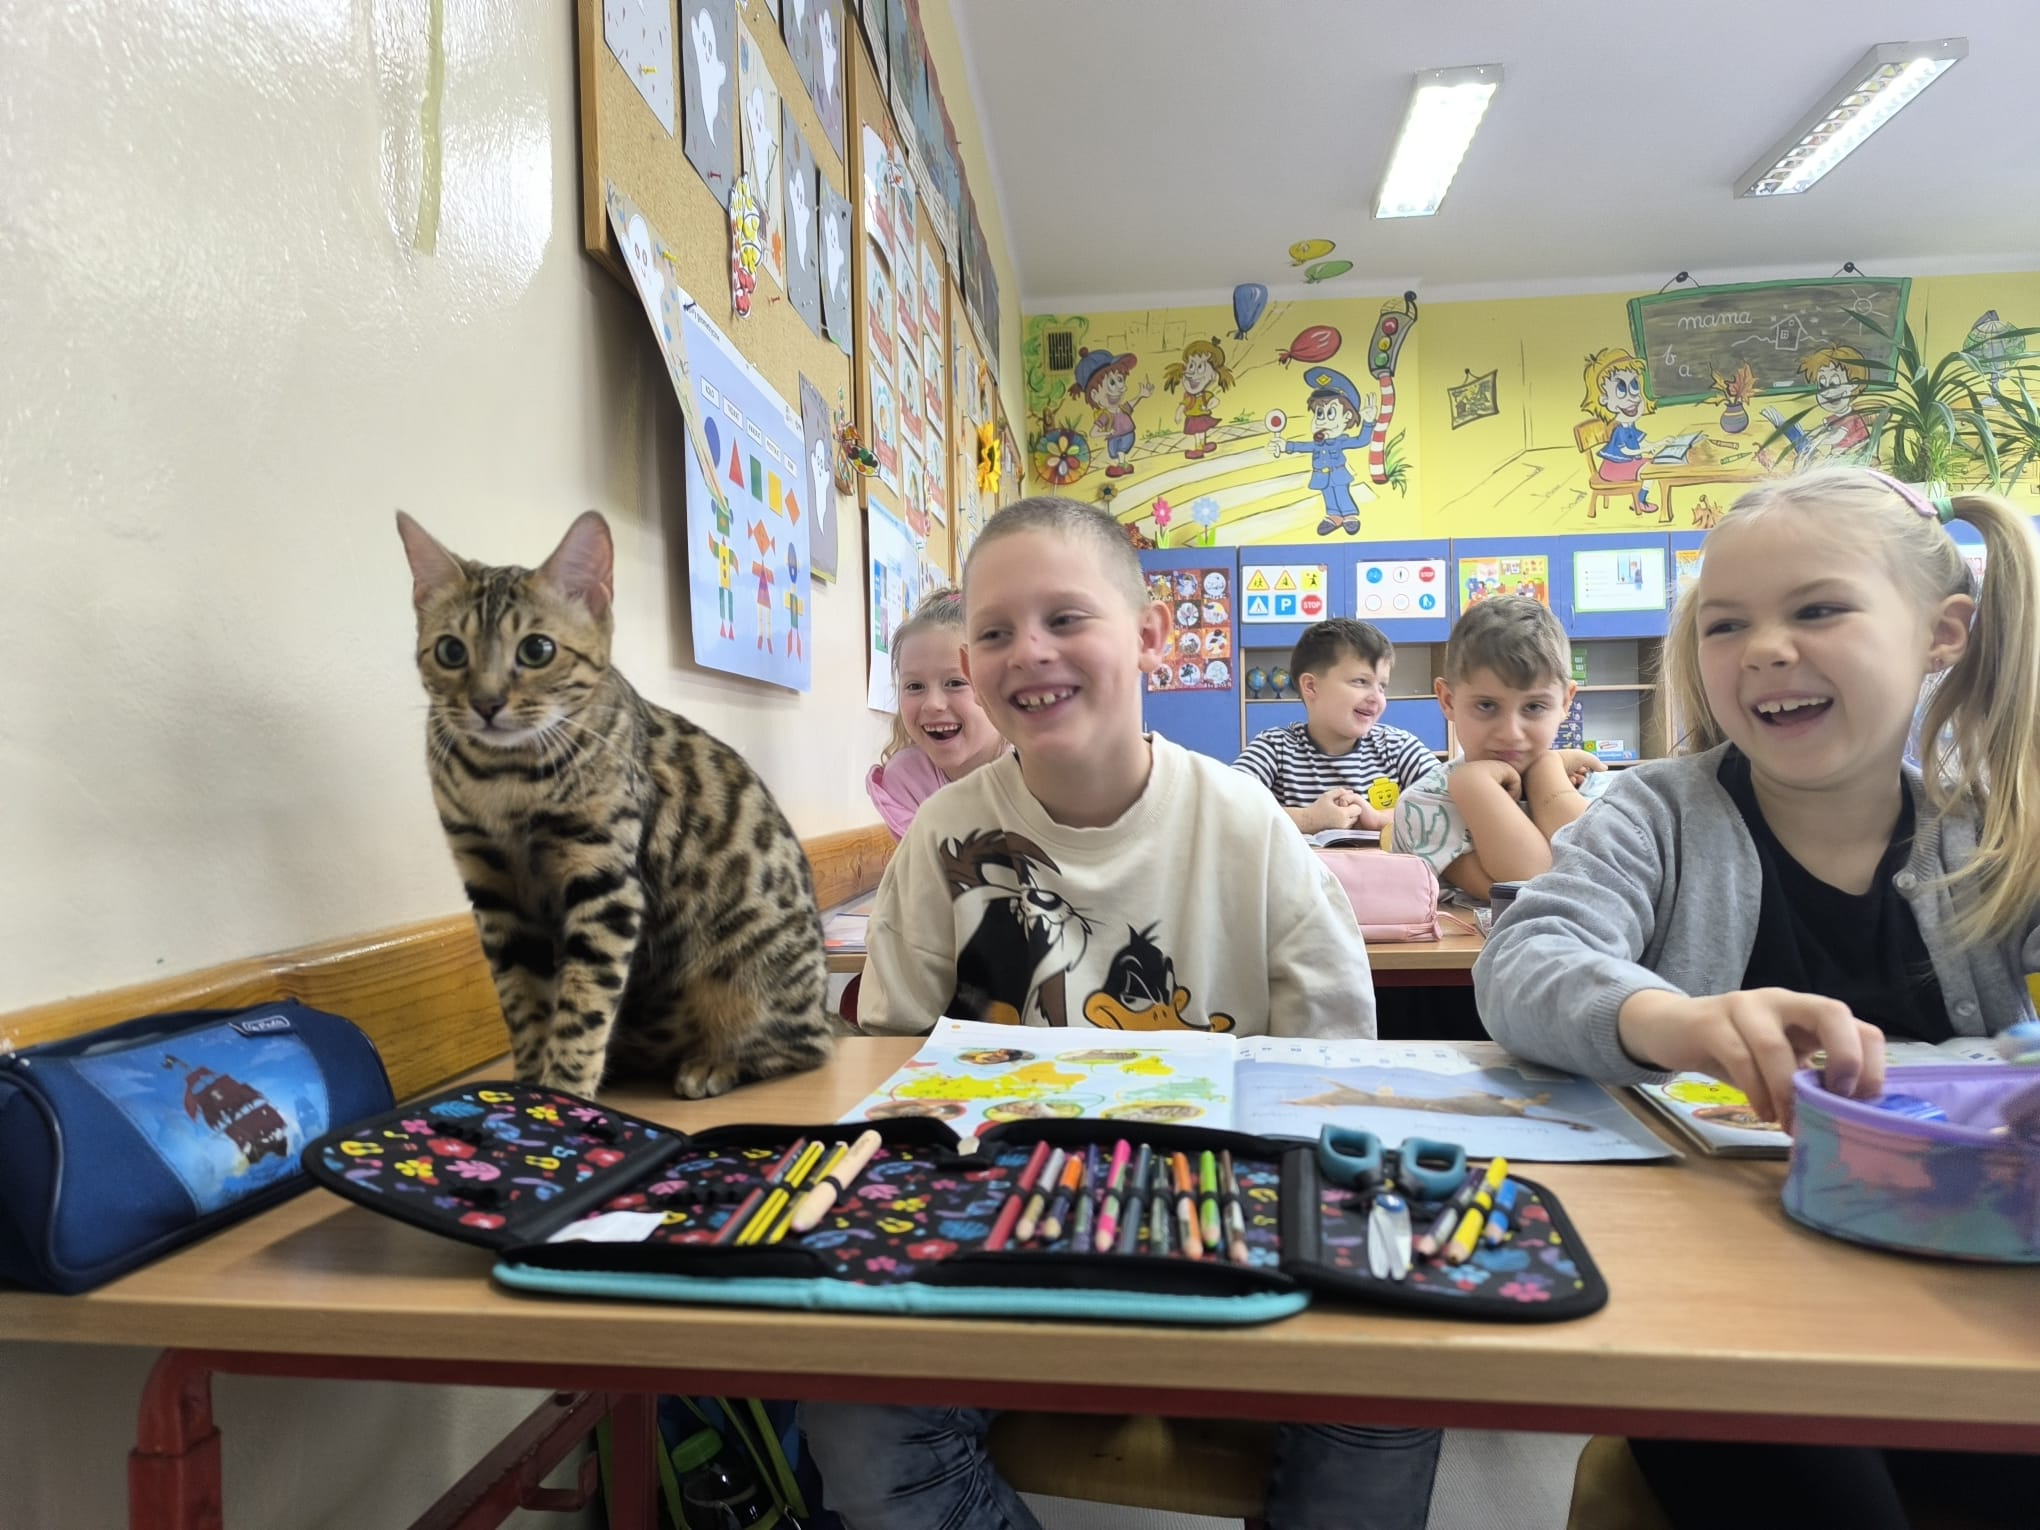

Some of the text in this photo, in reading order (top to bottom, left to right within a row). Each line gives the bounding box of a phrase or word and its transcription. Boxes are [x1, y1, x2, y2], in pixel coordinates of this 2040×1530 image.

[1677, 311, 1753, 330] mama
[1678, 364, 1692, 377] a
[1281, 599, 1292, 611] P
[1303, 599, 1322, 609] STOP
